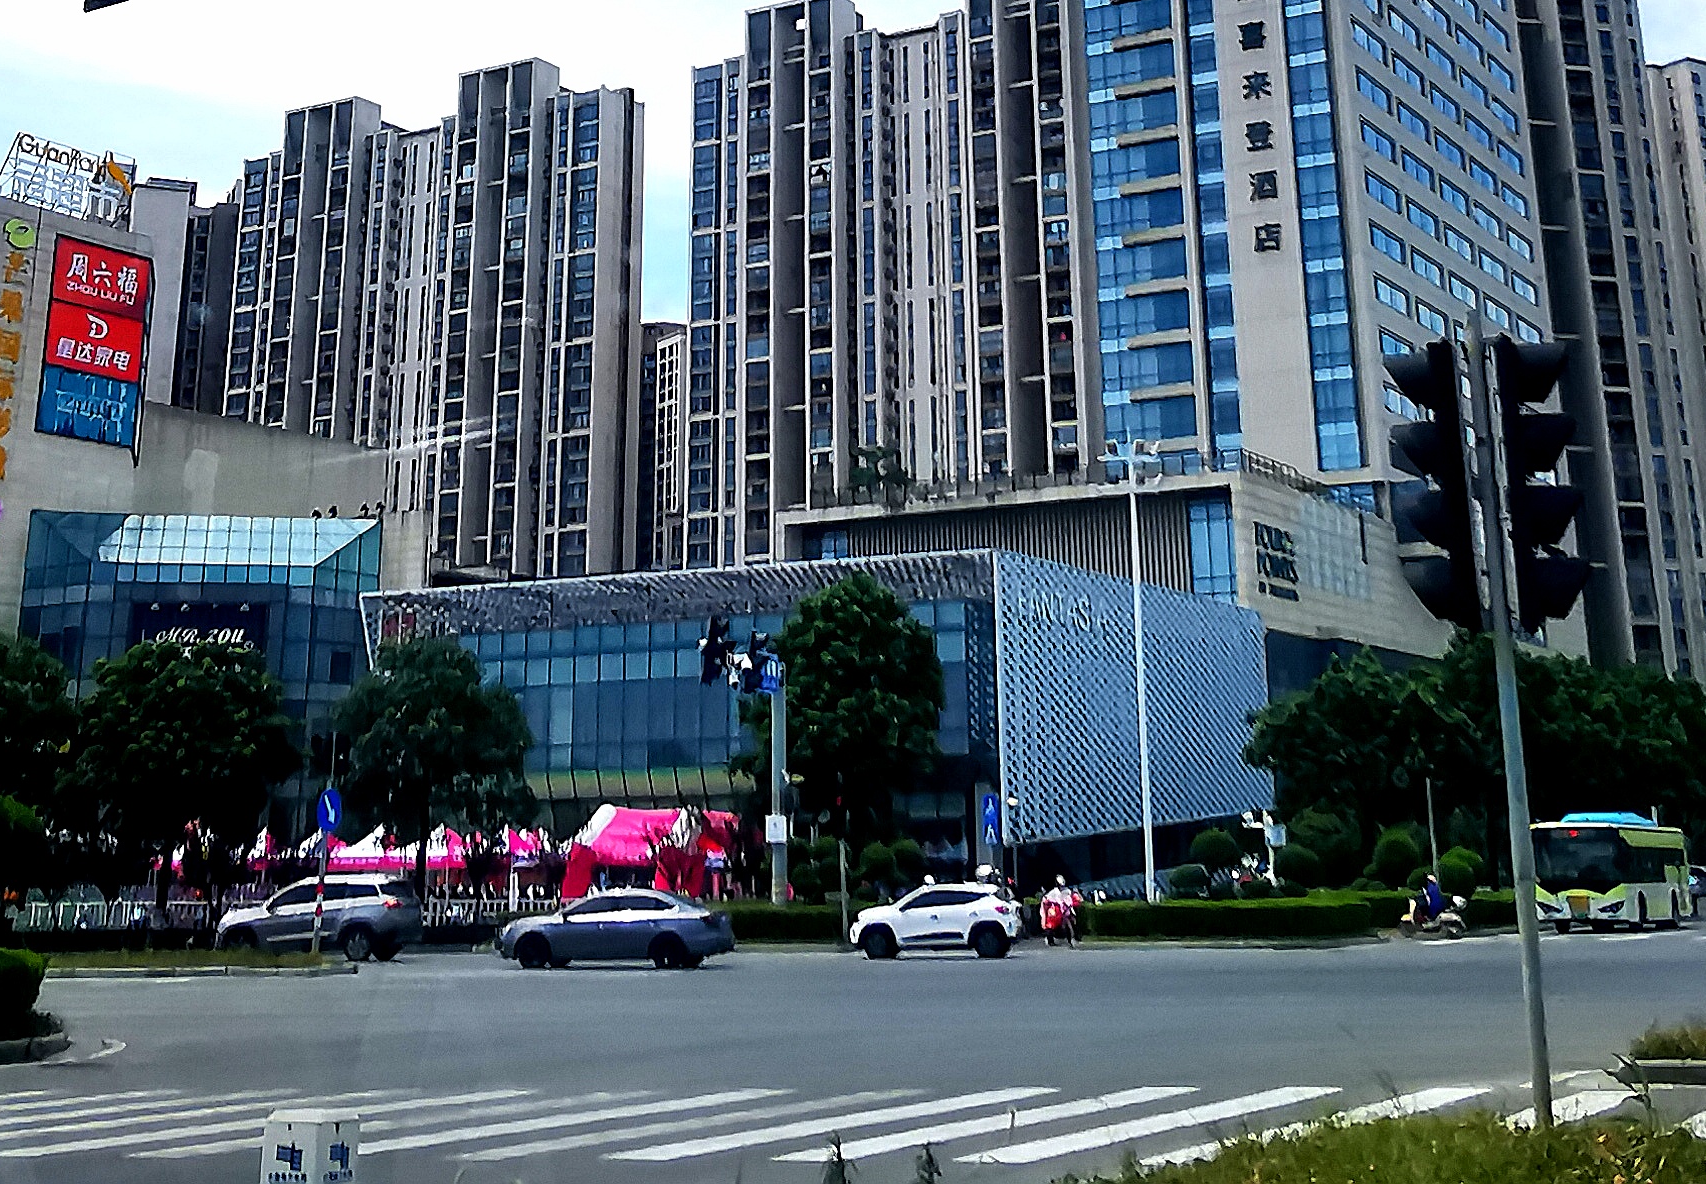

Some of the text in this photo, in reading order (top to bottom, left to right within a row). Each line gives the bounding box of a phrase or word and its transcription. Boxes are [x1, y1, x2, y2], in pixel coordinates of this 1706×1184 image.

[67, 253, 138, 295] 周六福
[66, 280, 98, 298] ZHOU
[119, 293, 135, 306] FU
